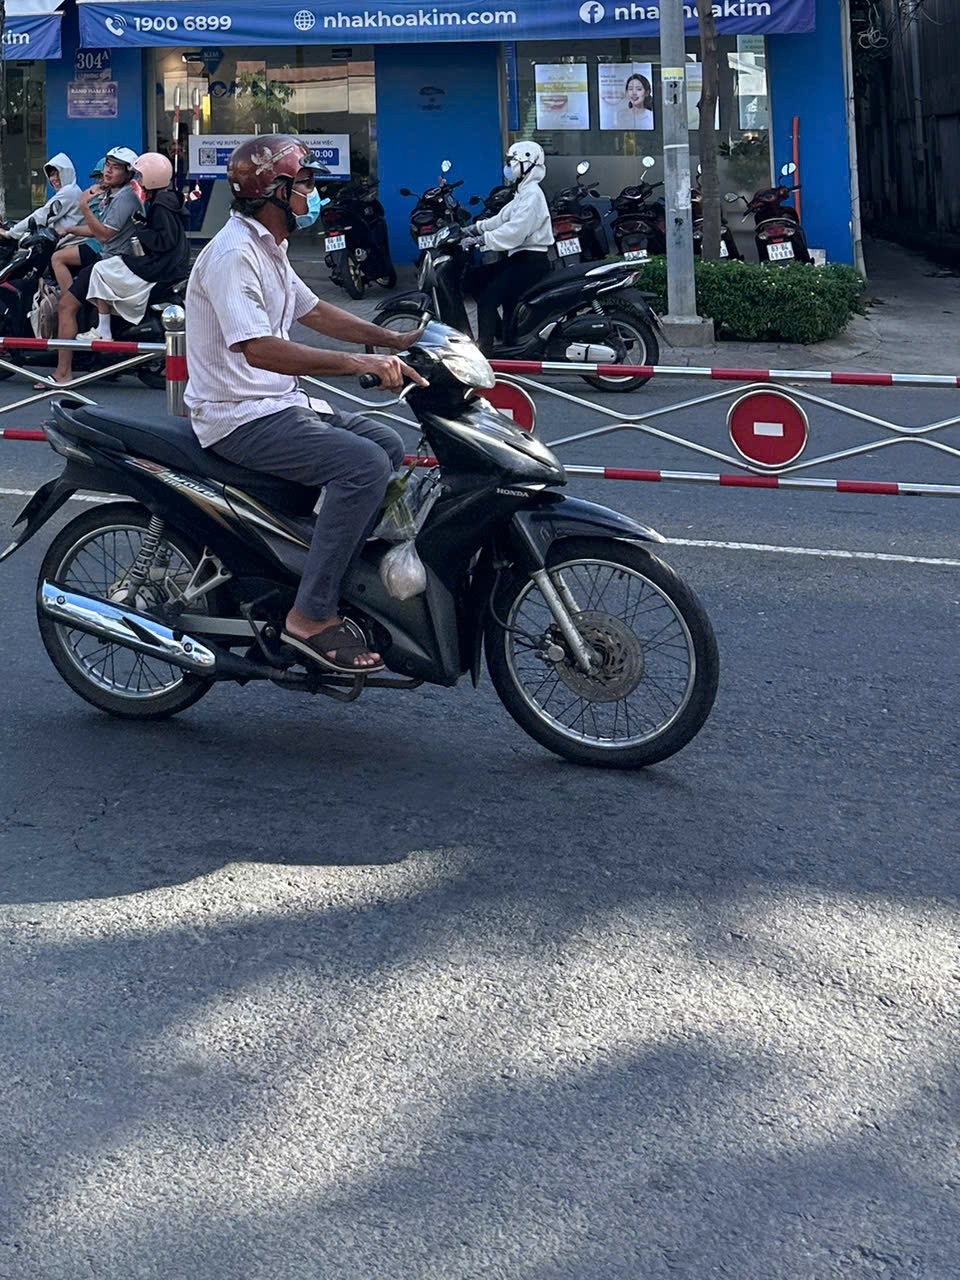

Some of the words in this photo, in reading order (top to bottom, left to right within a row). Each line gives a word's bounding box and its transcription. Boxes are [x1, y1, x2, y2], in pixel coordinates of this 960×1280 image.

[134, 16, 178, 32] 1900
[183, 15, 232, 31] 6899
[323, 8, 517, 28] nhakhoakim.com
[496, 487, 530, 497] HONDA
